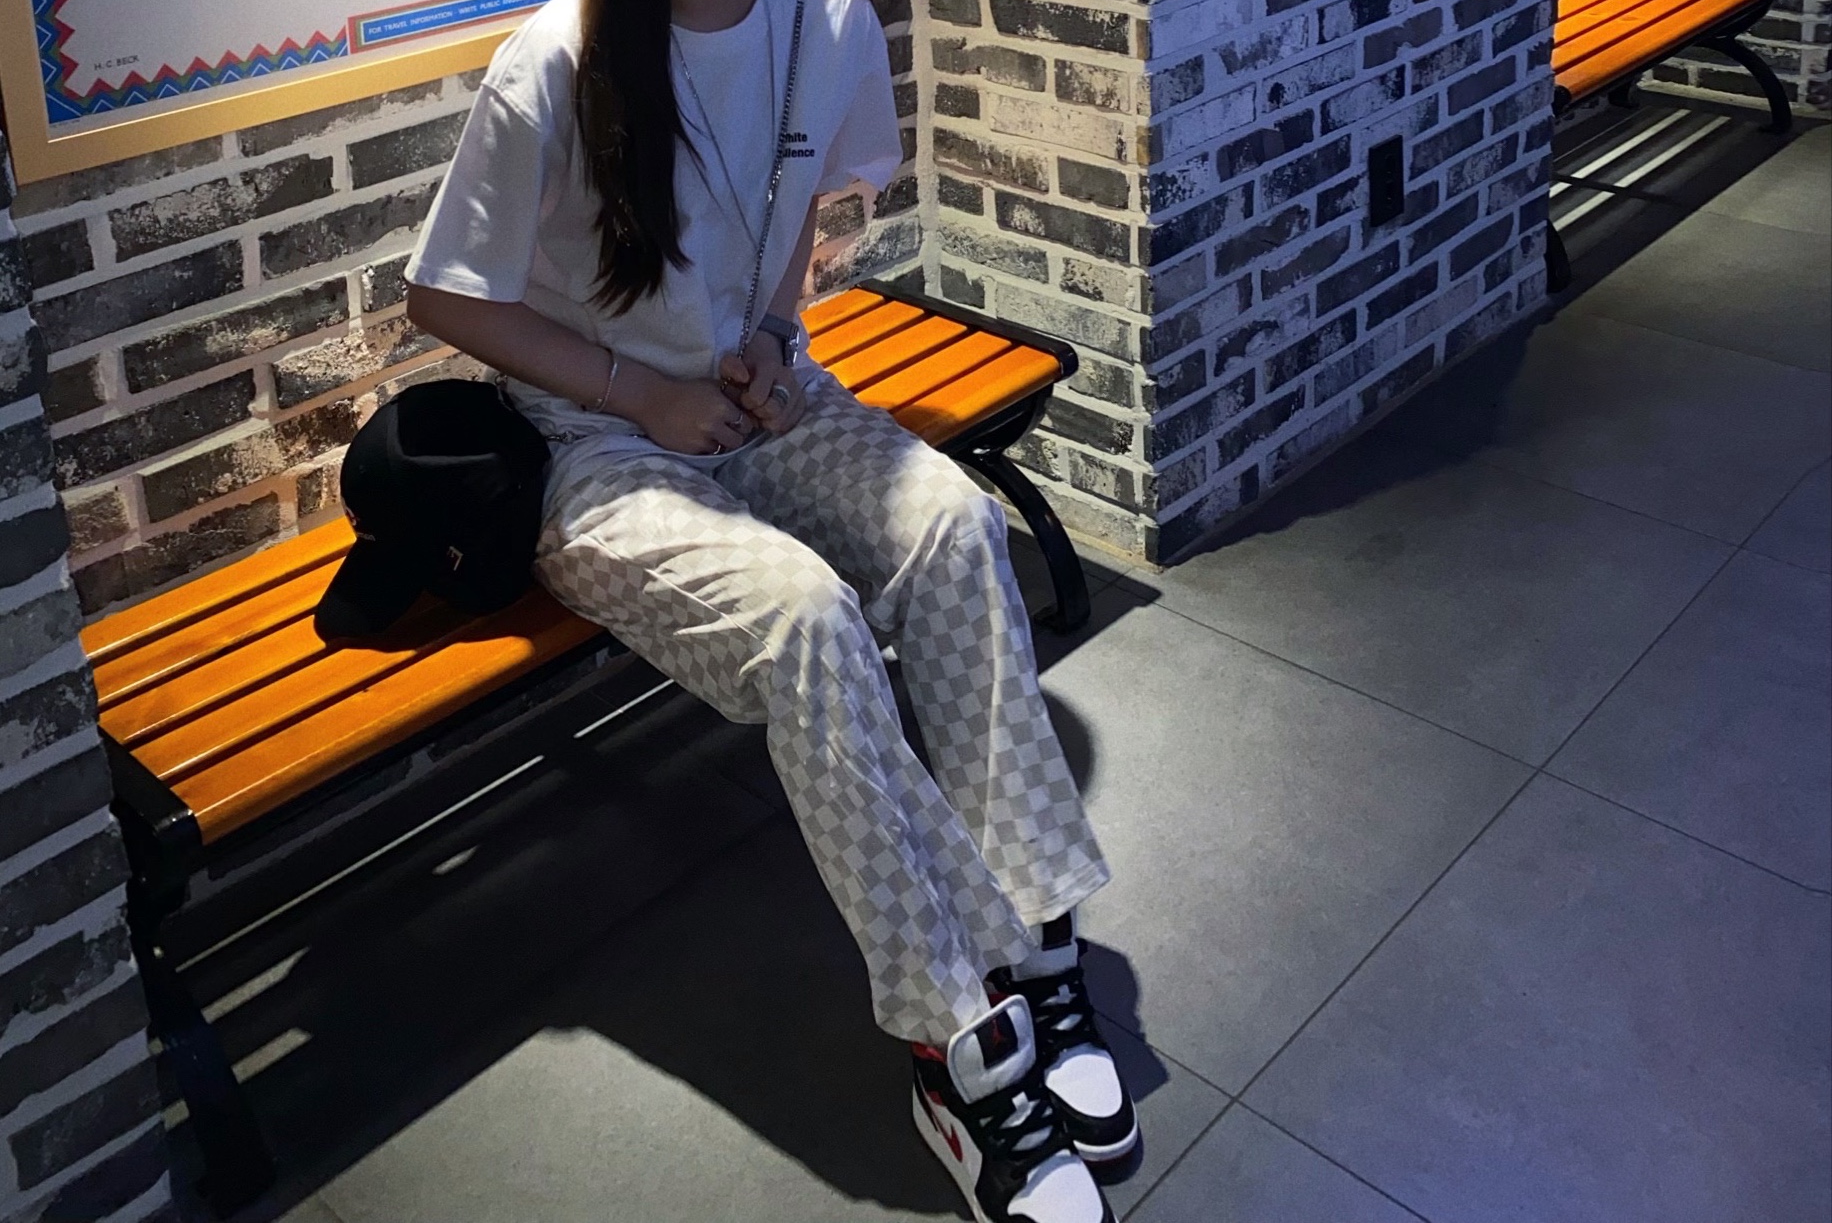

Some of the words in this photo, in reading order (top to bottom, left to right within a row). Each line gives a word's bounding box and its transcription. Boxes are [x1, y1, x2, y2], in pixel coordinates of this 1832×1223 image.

[368, 26, 382, 35] FOR
[384, 20, 408, 32] TRAVEL
[410, 10, 454, 26] INFORMATION
[117, 55, 140, 67] BECK
[780, 132, 808, 144] hite
[781, 148, 815, 158] ilence
